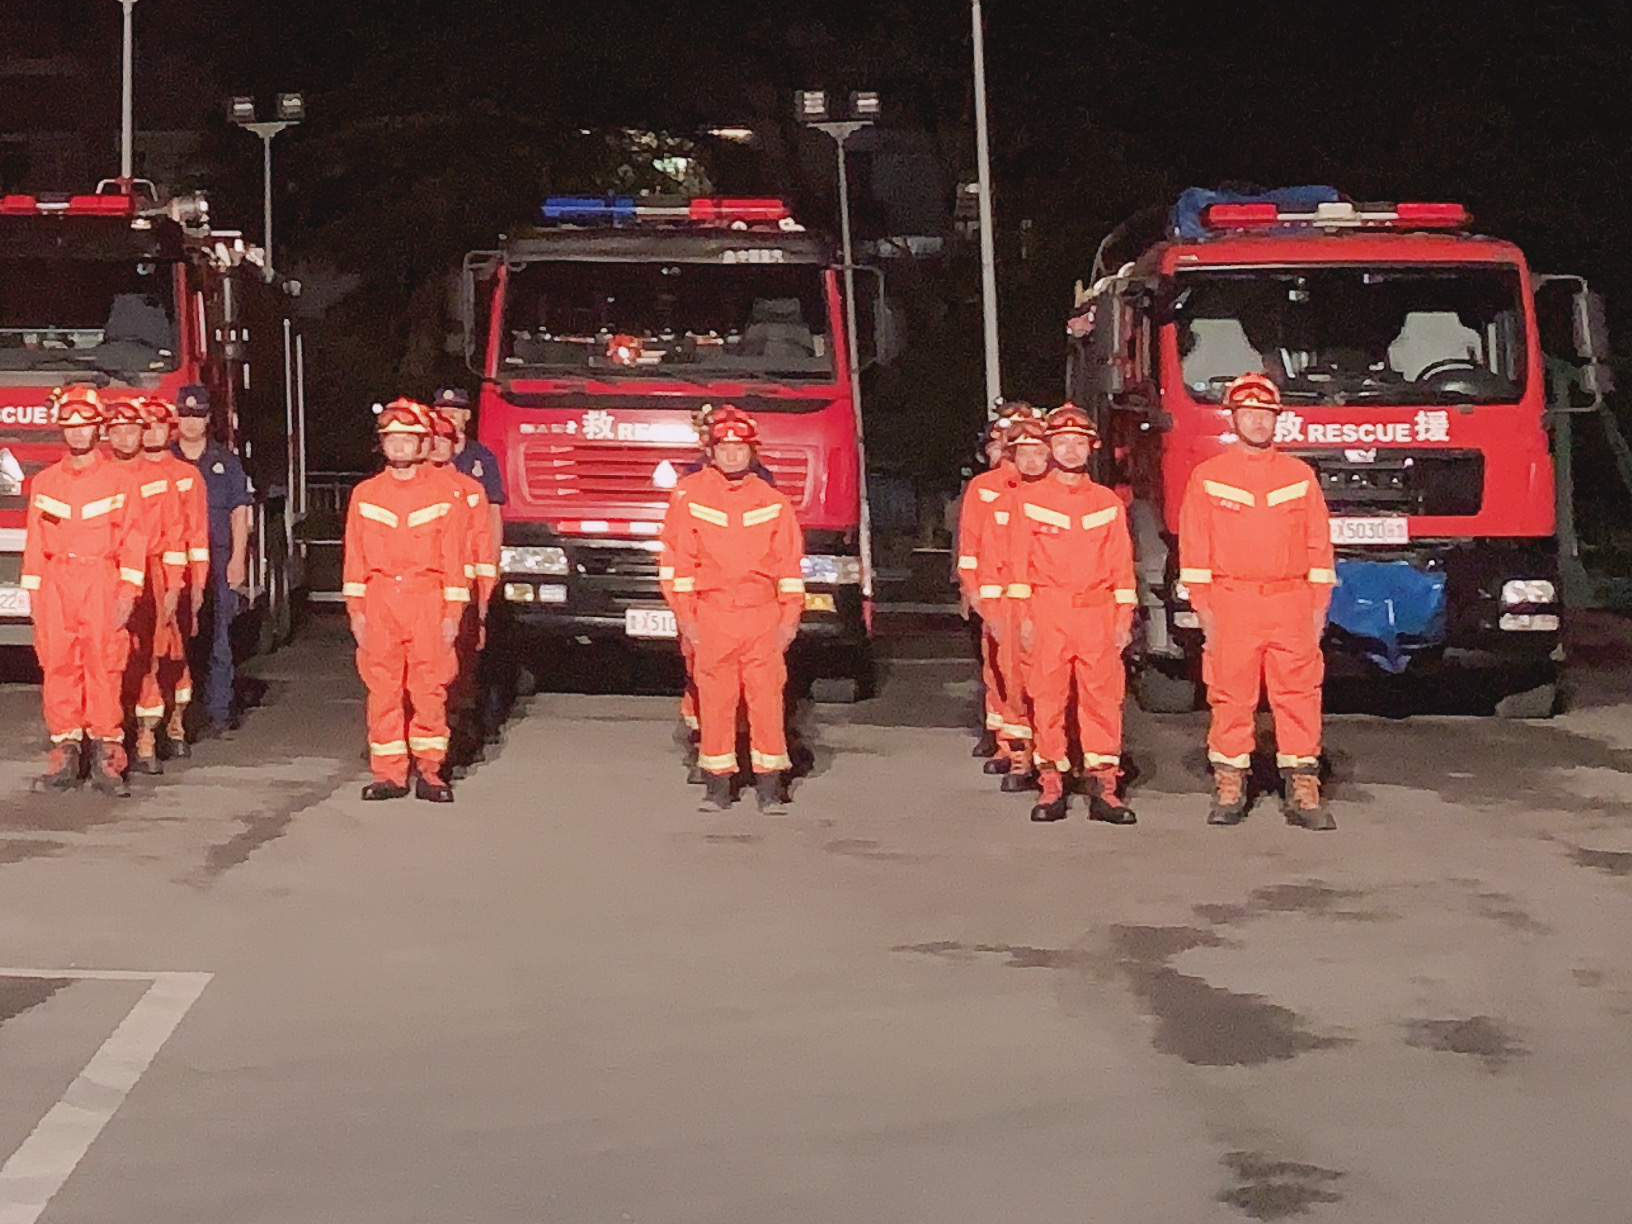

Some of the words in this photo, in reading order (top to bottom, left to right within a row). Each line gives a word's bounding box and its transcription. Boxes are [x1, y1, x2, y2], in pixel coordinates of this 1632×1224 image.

[582, 409, 615, 441] 救
[1307, 423, 1412, 443] RESCUE
[1414, 410, 1450, 442] 援
